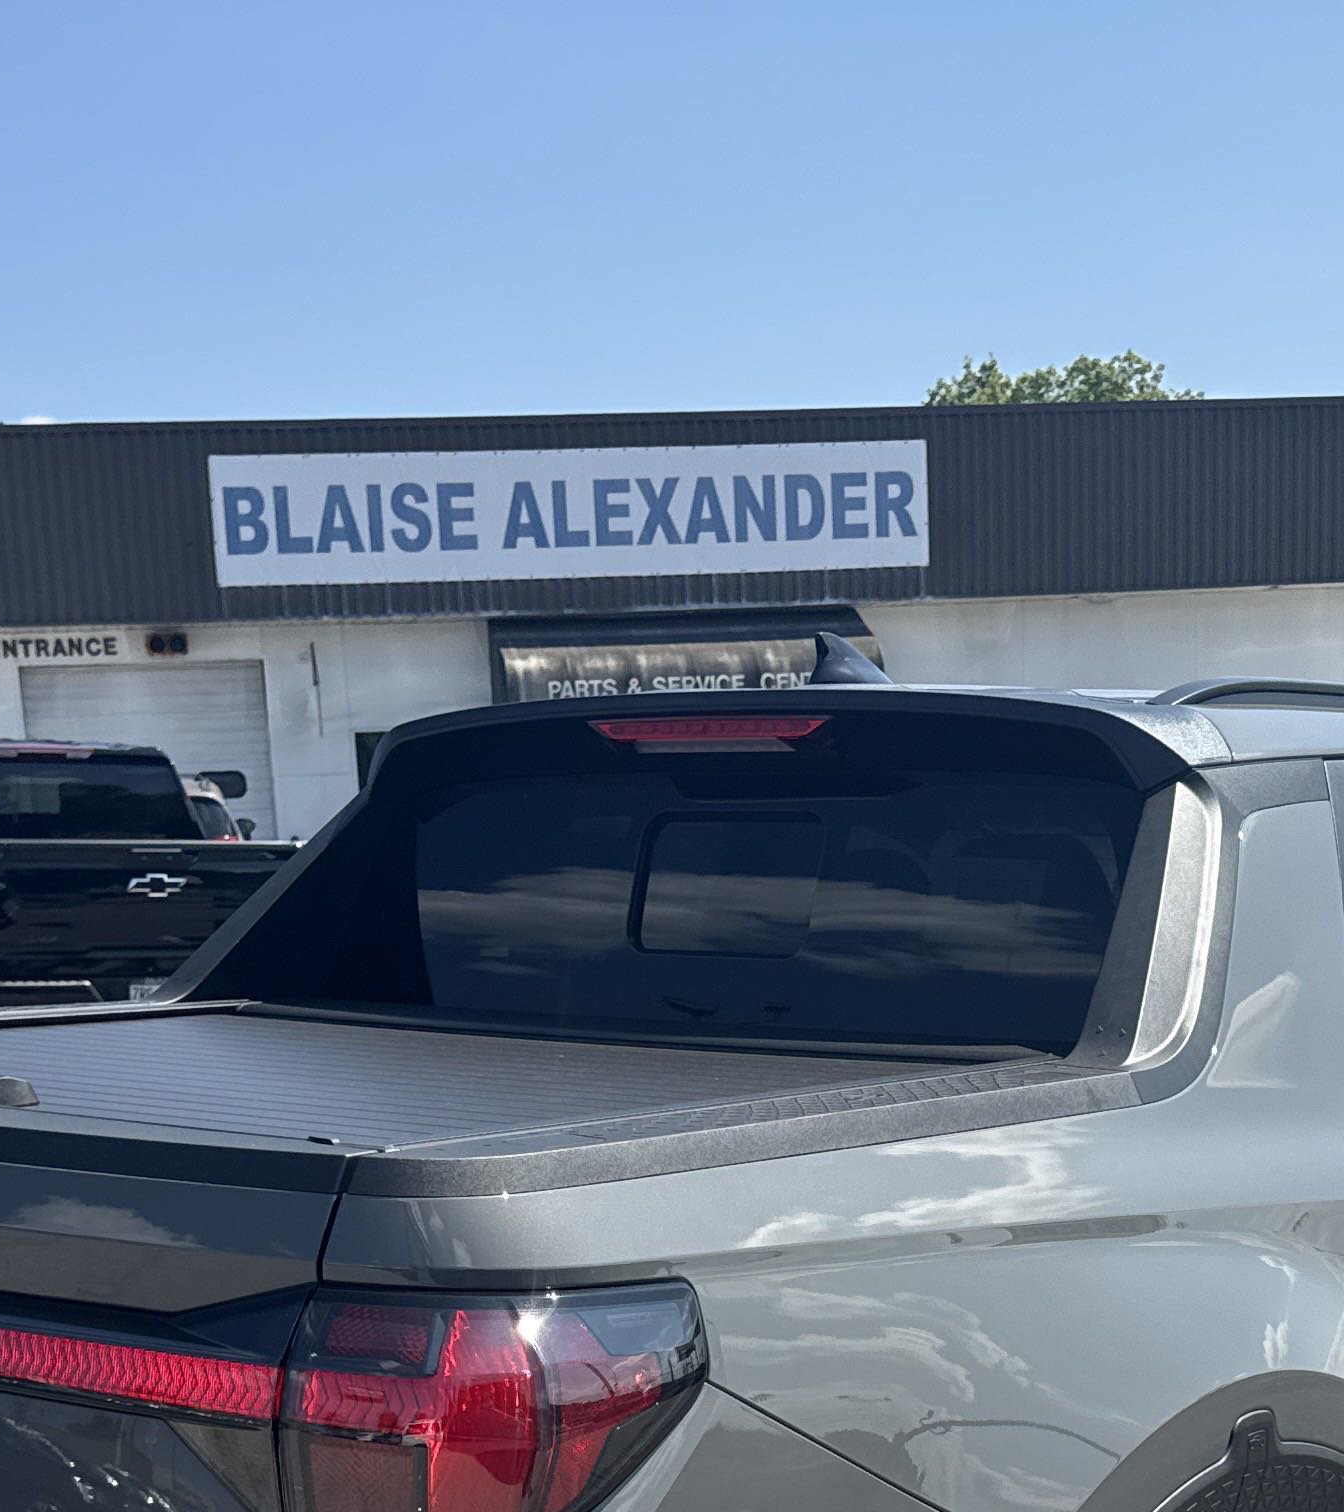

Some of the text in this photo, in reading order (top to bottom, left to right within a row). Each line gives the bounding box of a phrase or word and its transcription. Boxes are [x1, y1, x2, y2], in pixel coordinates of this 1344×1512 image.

[222, 471, 916, 555] BLAISE ALEXANDER
[548, 678, 617, 699] PARTS
[628, 677, 642, 694] &
[653, 674, 745, 691] SERVICE
